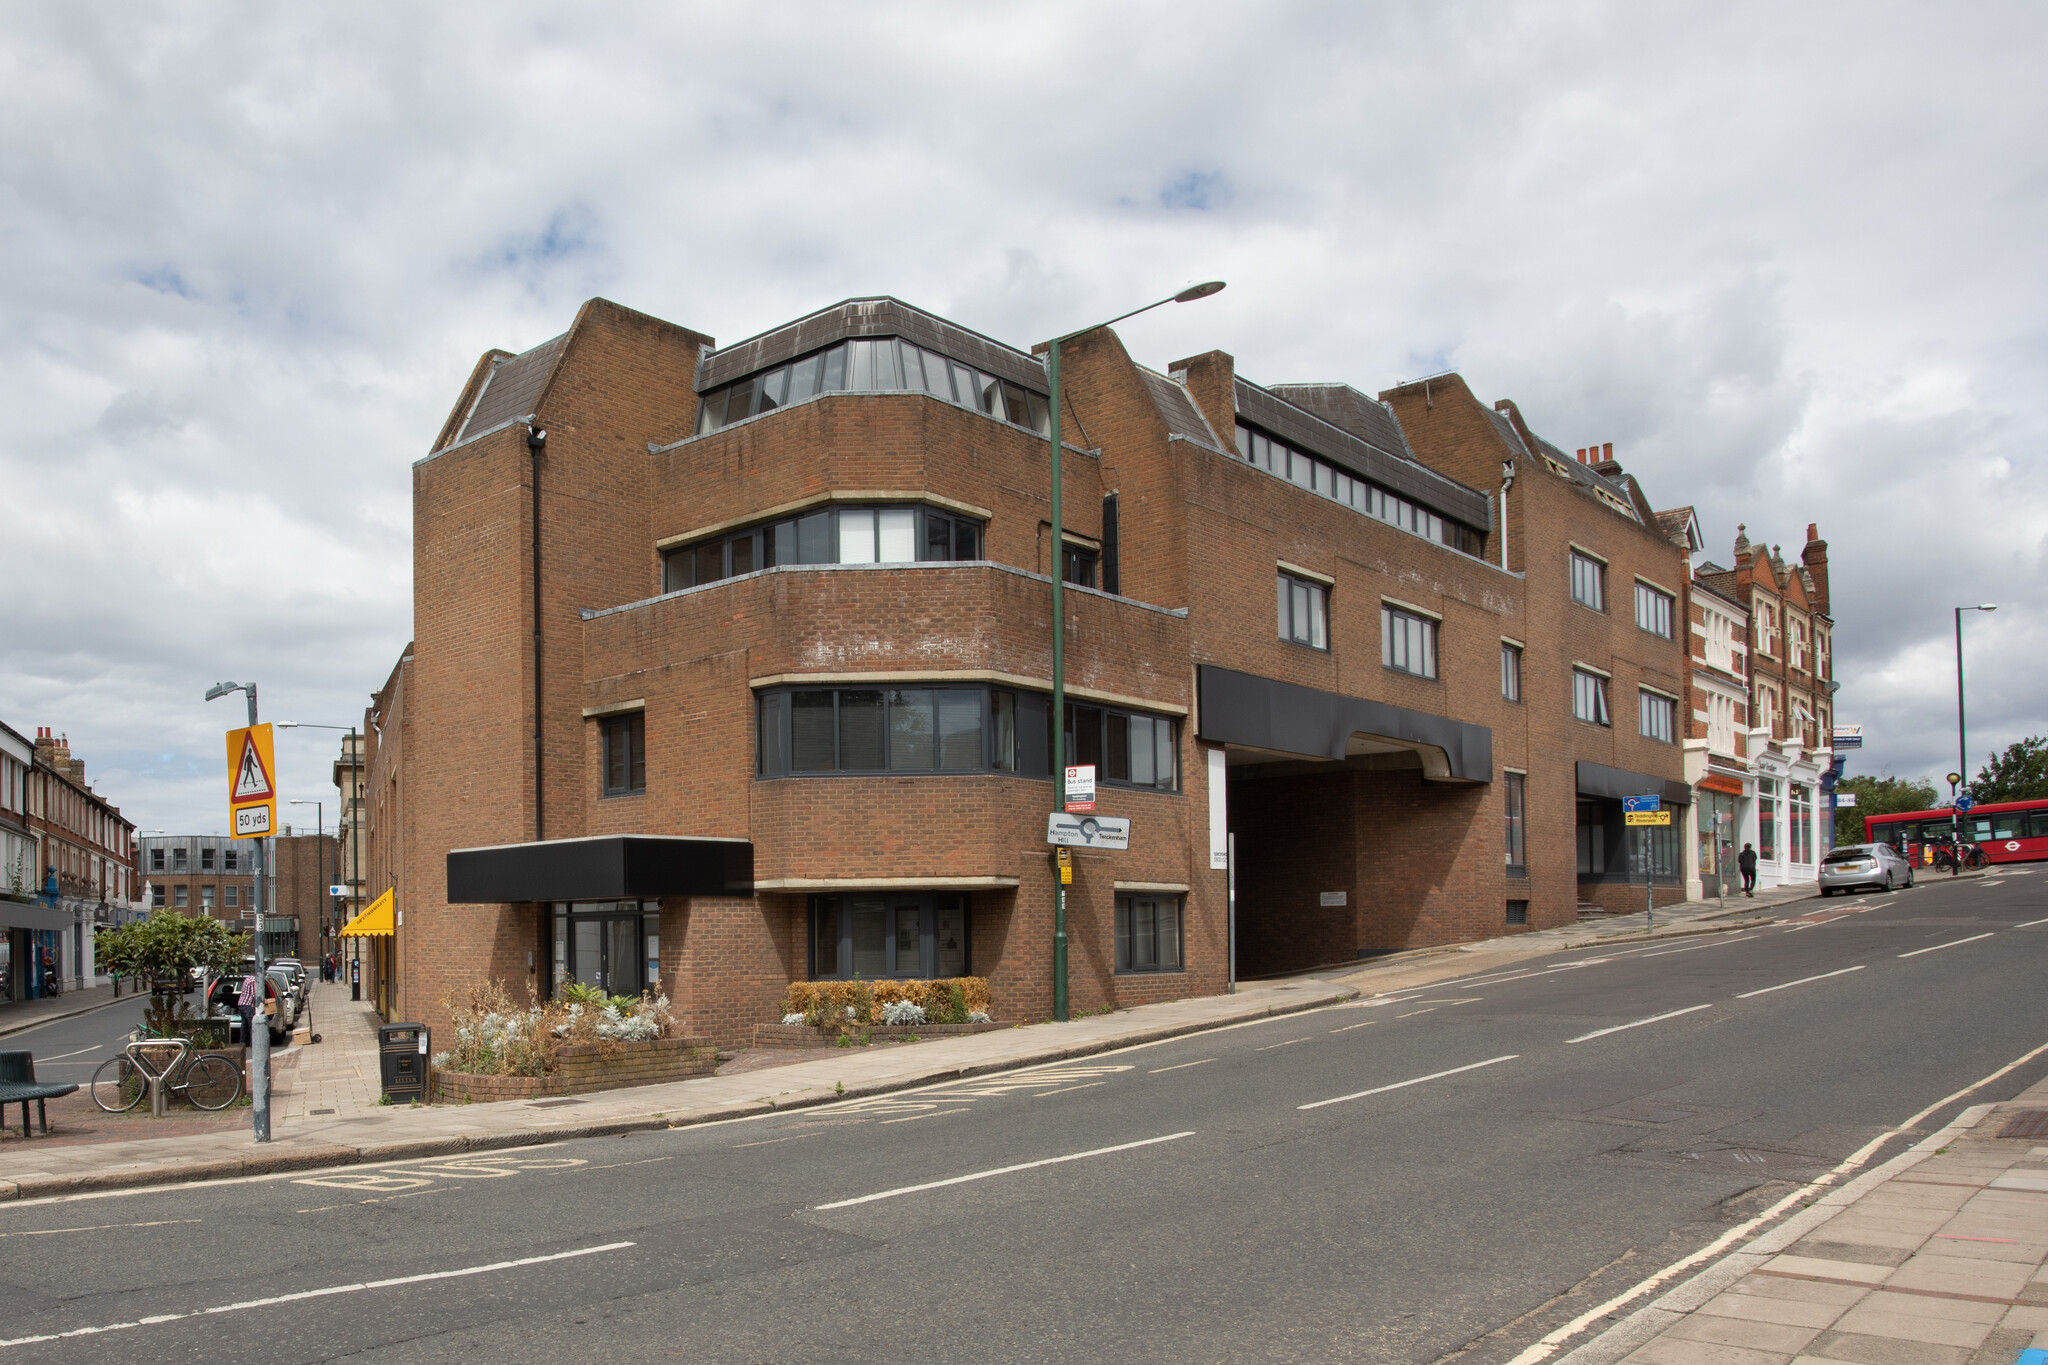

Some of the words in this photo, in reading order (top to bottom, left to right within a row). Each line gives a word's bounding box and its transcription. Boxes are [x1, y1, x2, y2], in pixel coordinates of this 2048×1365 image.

[239, 814, 250, 826] 50
[252, 812, 267, 827] yds
[1050, 829, 1078, 837] Hampton
[1099, 833, 1127, 841] Twickenham
[214, 1027, 226, 1036] 31
